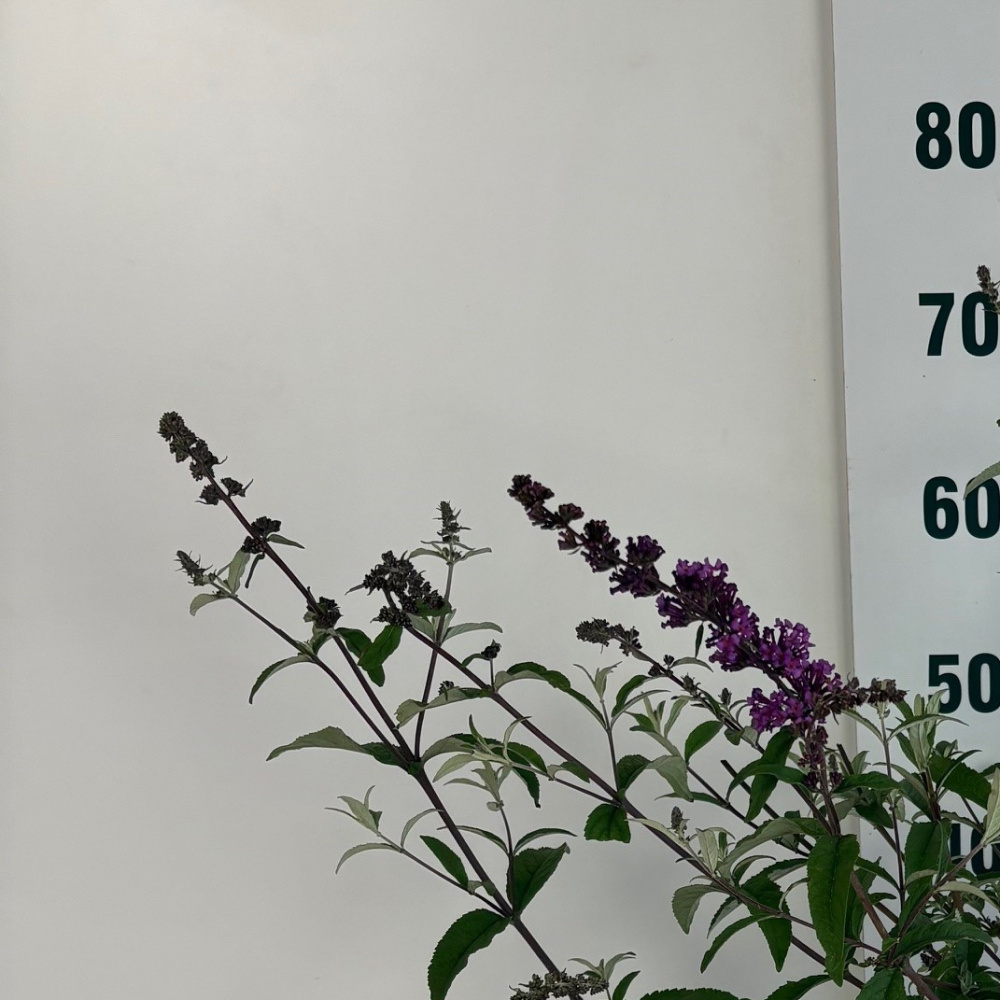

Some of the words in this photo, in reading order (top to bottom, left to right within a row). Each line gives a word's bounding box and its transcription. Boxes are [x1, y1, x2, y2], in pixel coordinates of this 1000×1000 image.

[915, 101, 996, 170] 80
[918, 291, 999, 357] 70
[923, 476, 1000, 540] 60
